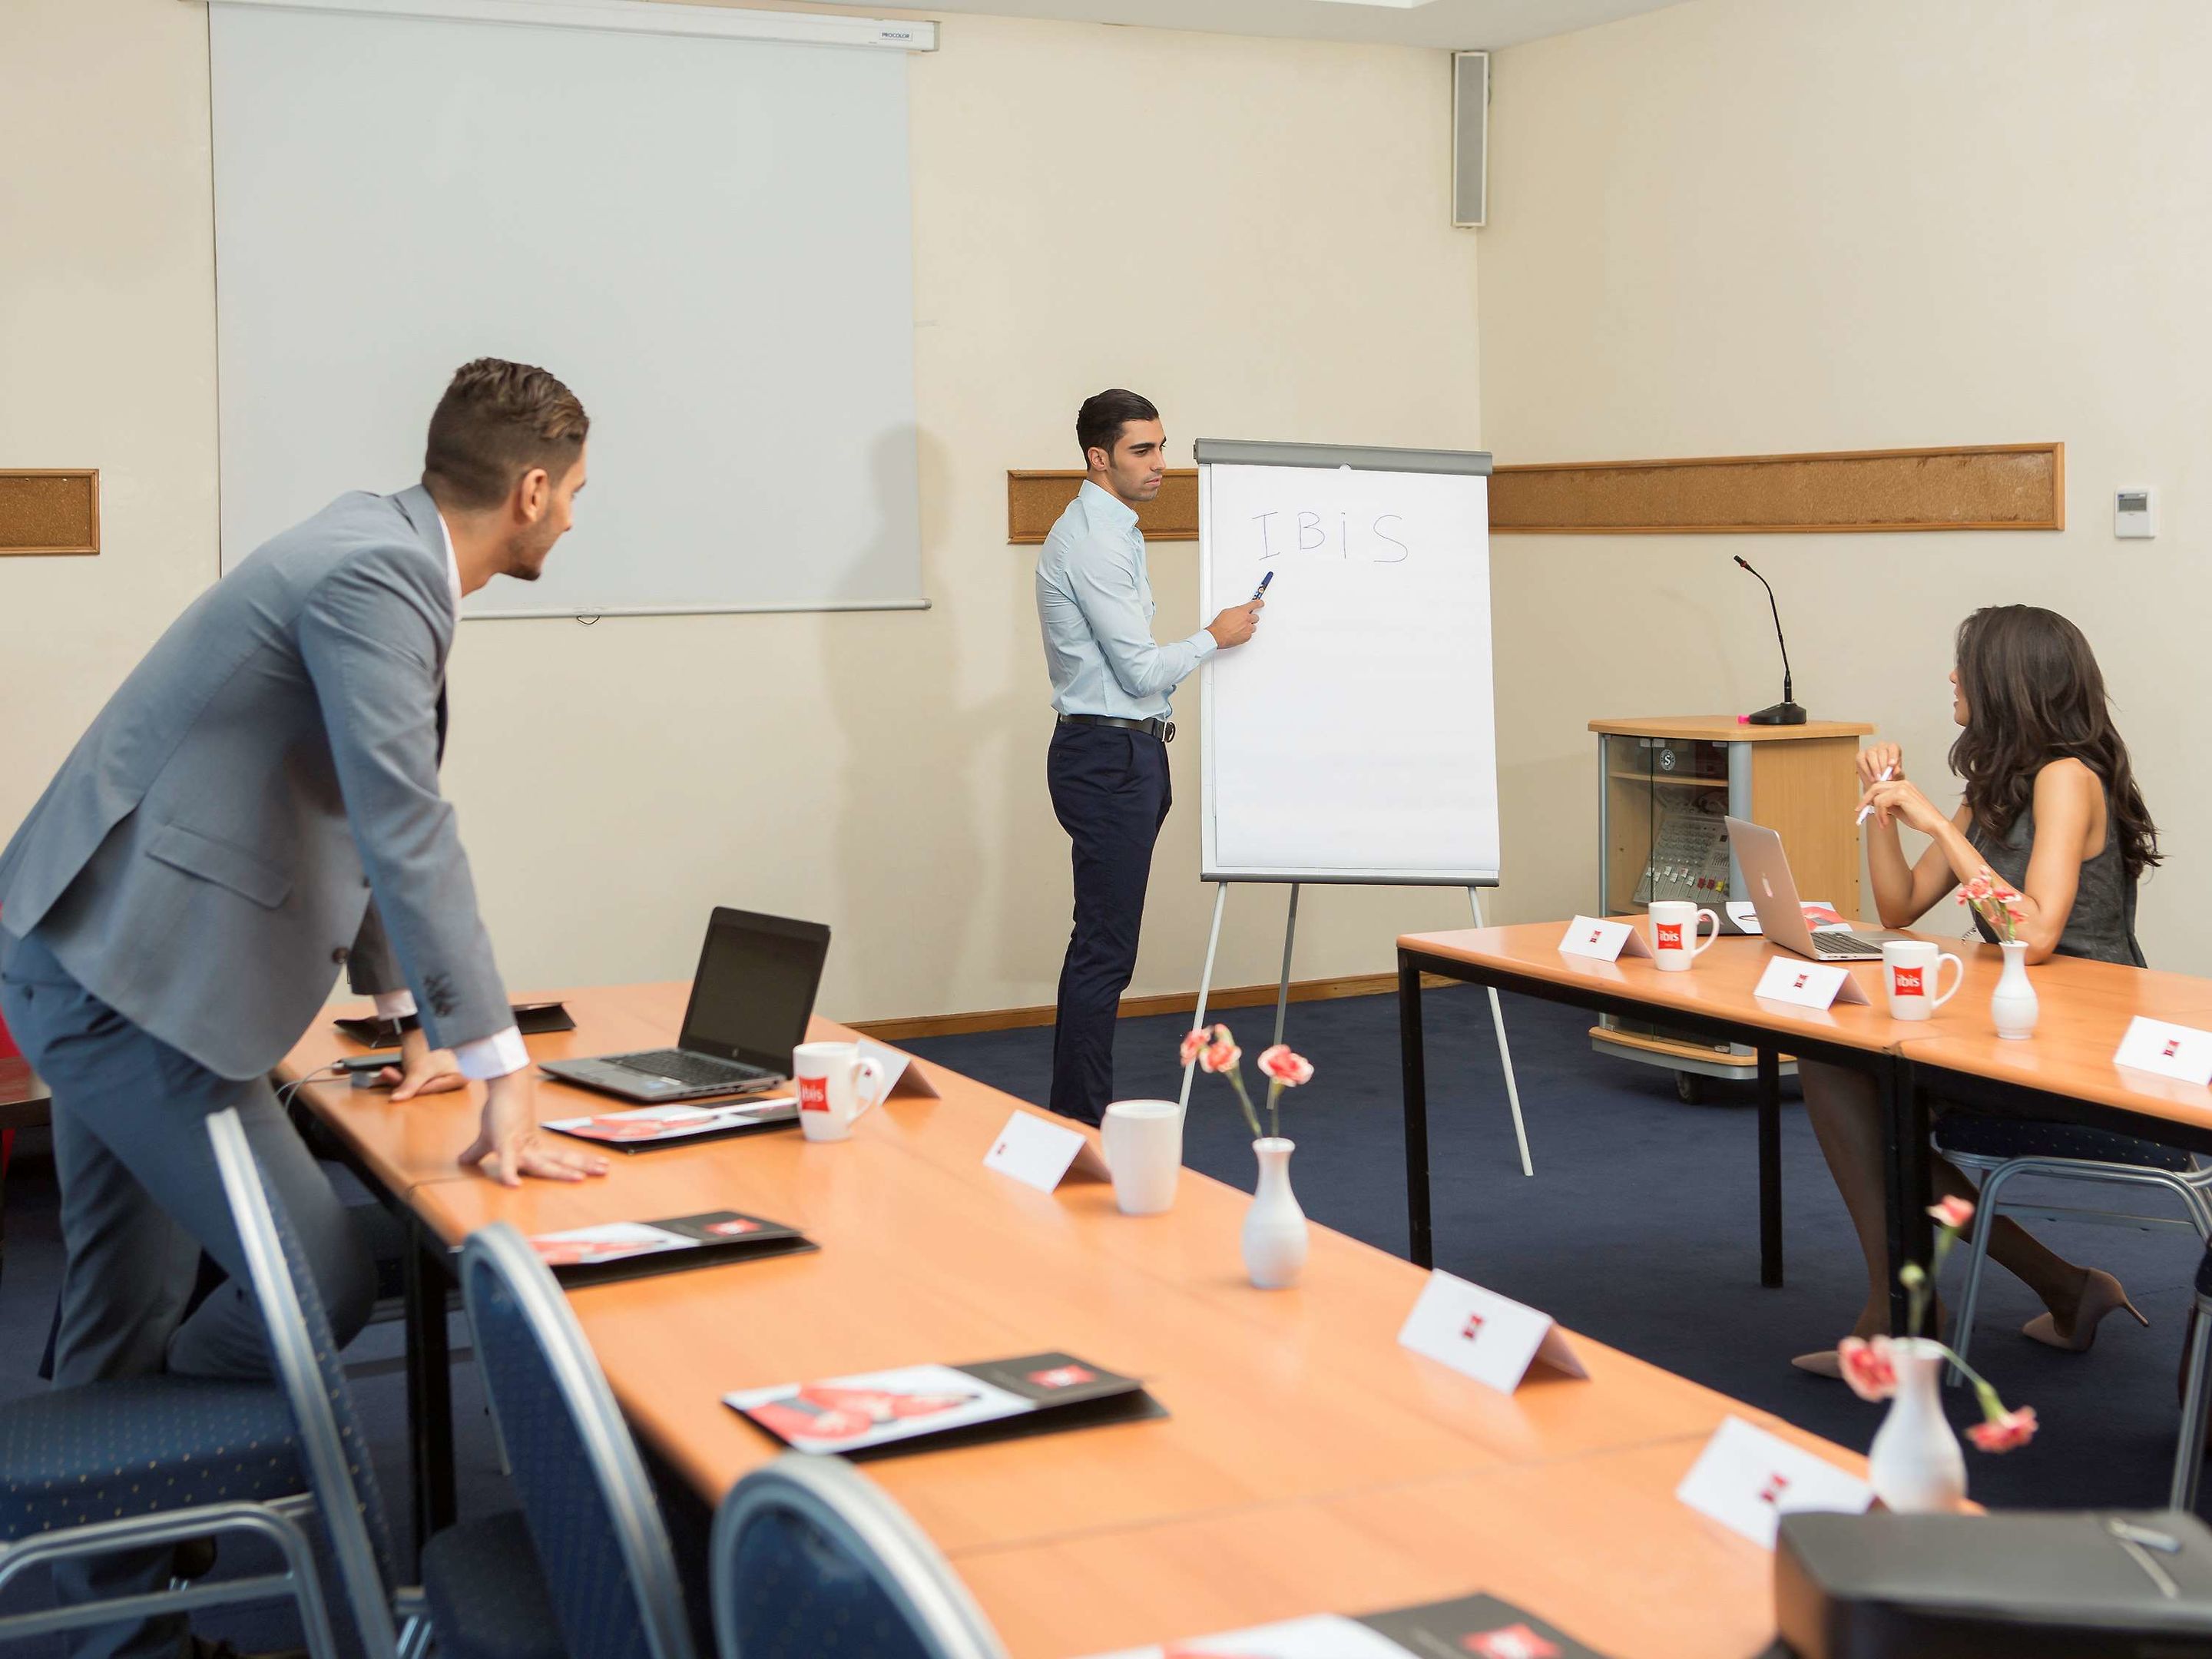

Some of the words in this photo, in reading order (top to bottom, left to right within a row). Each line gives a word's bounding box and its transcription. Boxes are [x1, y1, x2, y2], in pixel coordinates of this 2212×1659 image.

[1659, 930, 1680, 942] ibis
[1896, 974, 1920, 987] ibis
[801, 1084, 824, 1102] ibis
